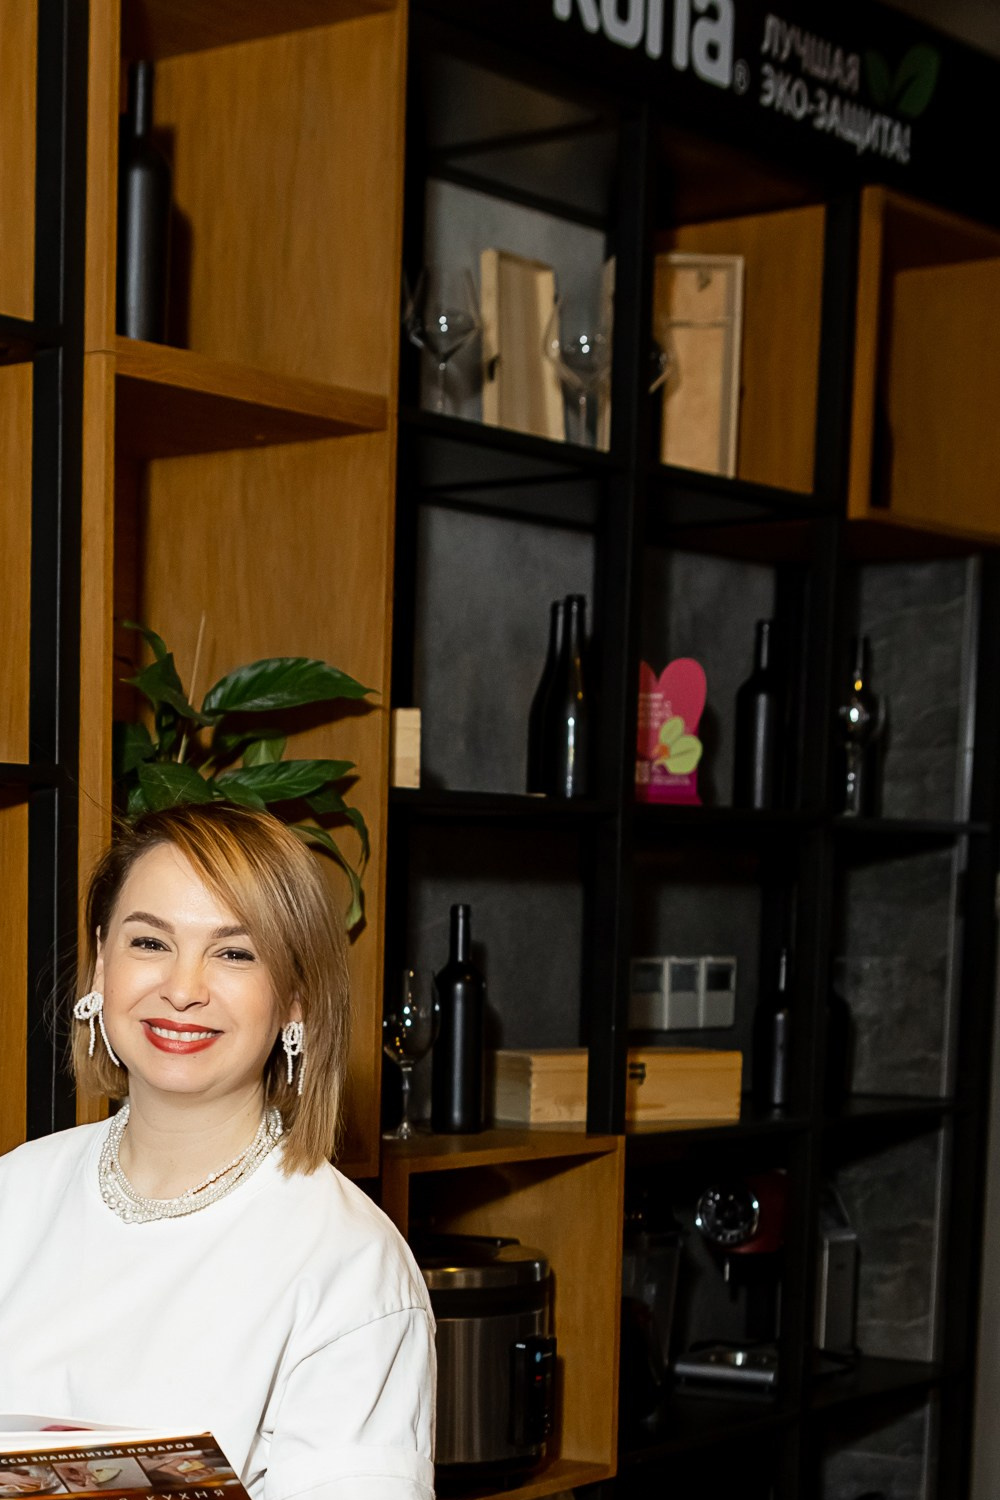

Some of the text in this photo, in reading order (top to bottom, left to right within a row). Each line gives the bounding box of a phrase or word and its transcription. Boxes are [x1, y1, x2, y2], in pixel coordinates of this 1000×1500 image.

[760, 12, 861, 95] ЛУЧШАЯ
[758, 61, 912, 165] ЭКО-ЗАЩИТА!
[31, 1449, 124, 1462] ЗНАМЕНИТЫХ
[126, 1442, 195, 1454] ПОВАРОВ
